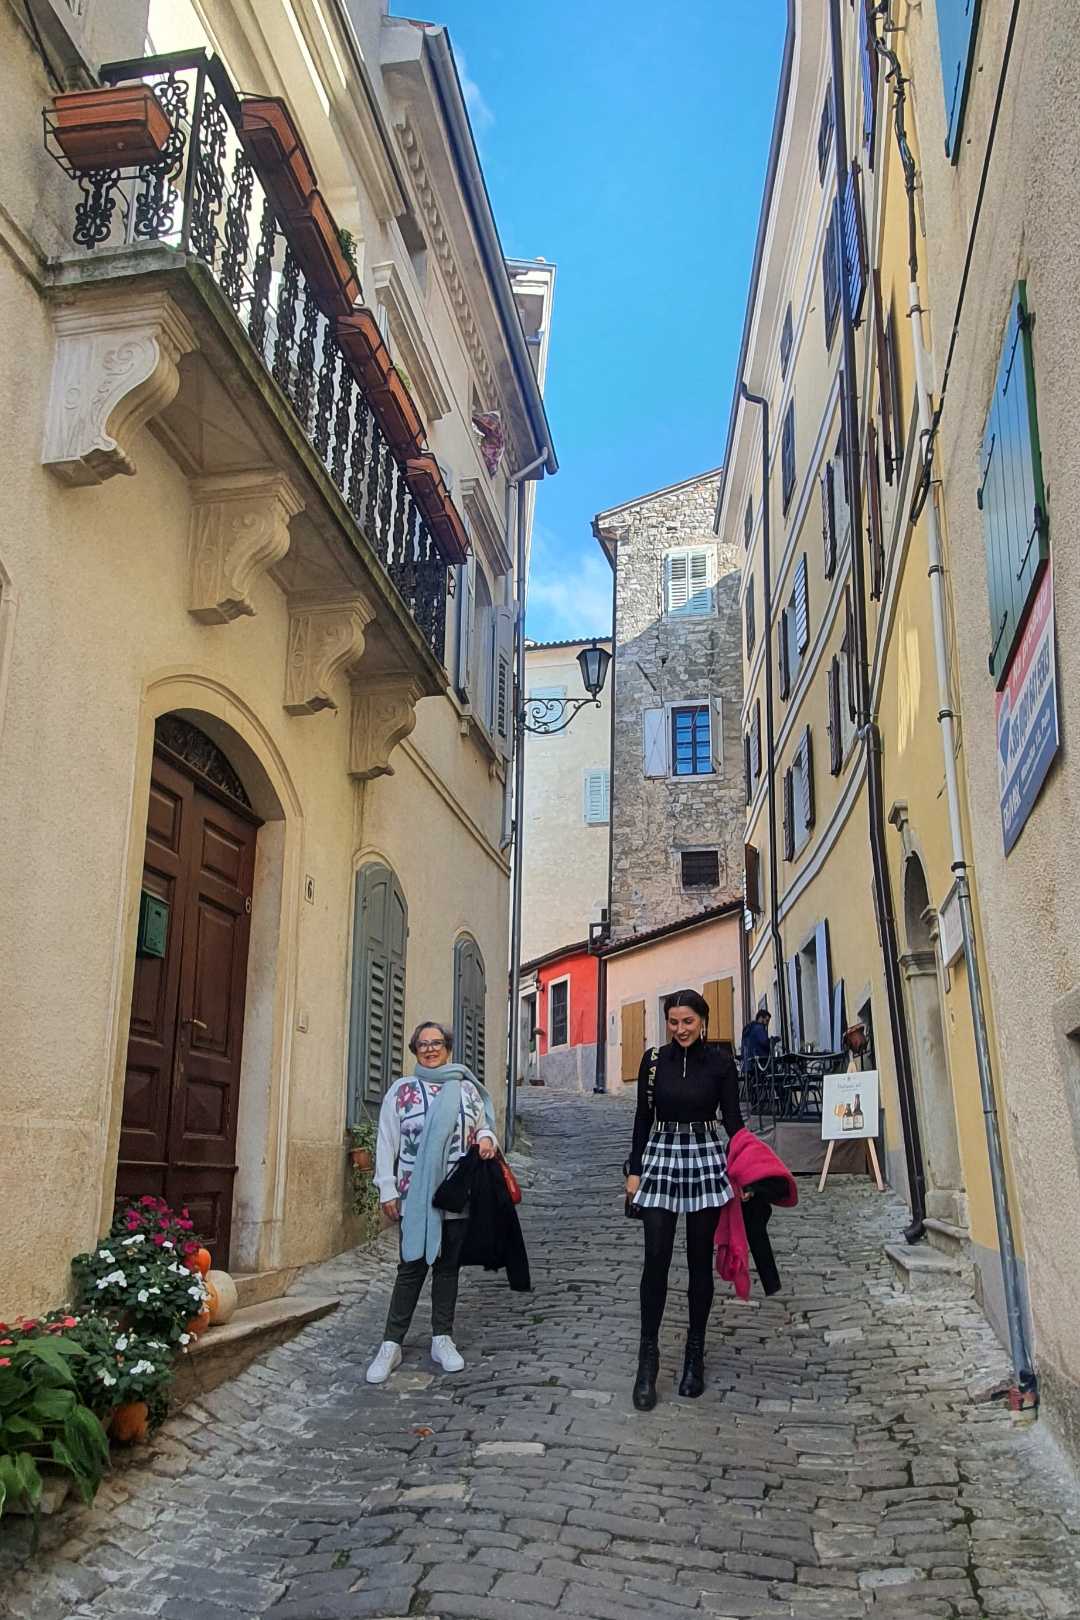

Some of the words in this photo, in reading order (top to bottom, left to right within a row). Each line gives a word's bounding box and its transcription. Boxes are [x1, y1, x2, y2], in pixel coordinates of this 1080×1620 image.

[308, 881, 313, 899] 6
[246, 897, 252, 914] 6
[649, 1066, 657, 1086] FILA
